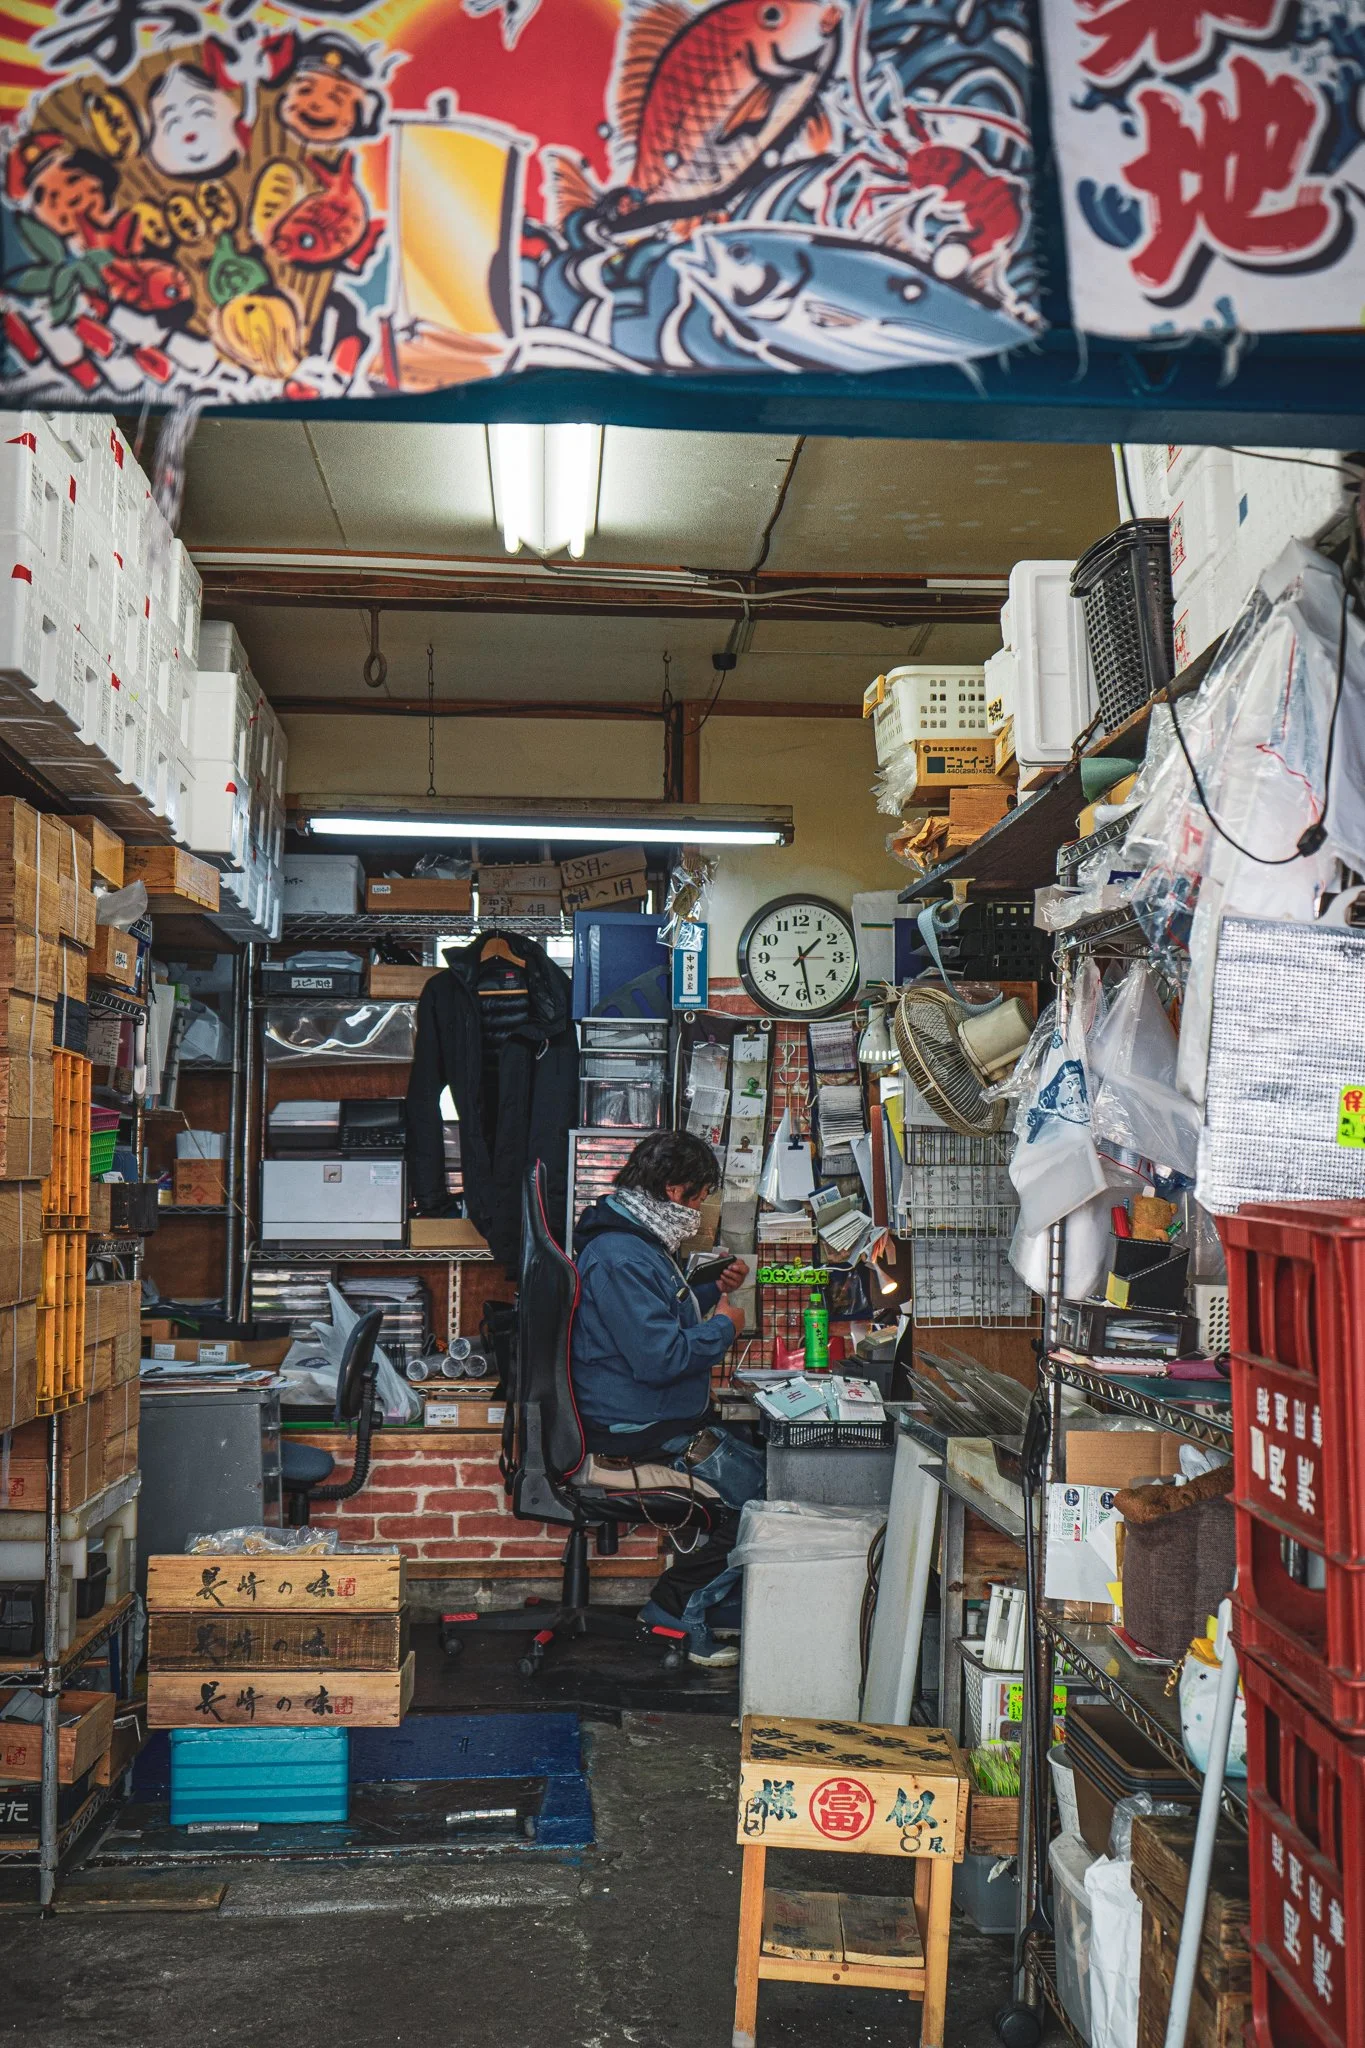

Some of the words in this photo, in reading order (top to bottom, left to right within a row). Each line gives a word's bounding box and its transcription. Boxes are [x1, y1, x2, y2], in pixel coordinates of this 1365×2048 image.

[947, 755, 996, 769] ニューイージ
[777, 920, 788, 931] 11
[792, 915, 810, 927] 12
[816, 920, 823, 931] 1
[762, 934, 778, 946] 10
[826, 933, 837, 945] 2
[758, 952, 771, 964] 9
[832, 951, 844, 963] 3
[764, 970, 777, 982] 8
[825, 969, 838, 981] 4
[778, 984, 790, 996] 7
[795, 988, 808, 1001] 6
[814, 984, 826, 996] 5
[195, 1566, 335, 1607] 長崎の味
[195, 1680, 334, 1723] 長崎の味
[818, 1782, 866, 1833] 富
